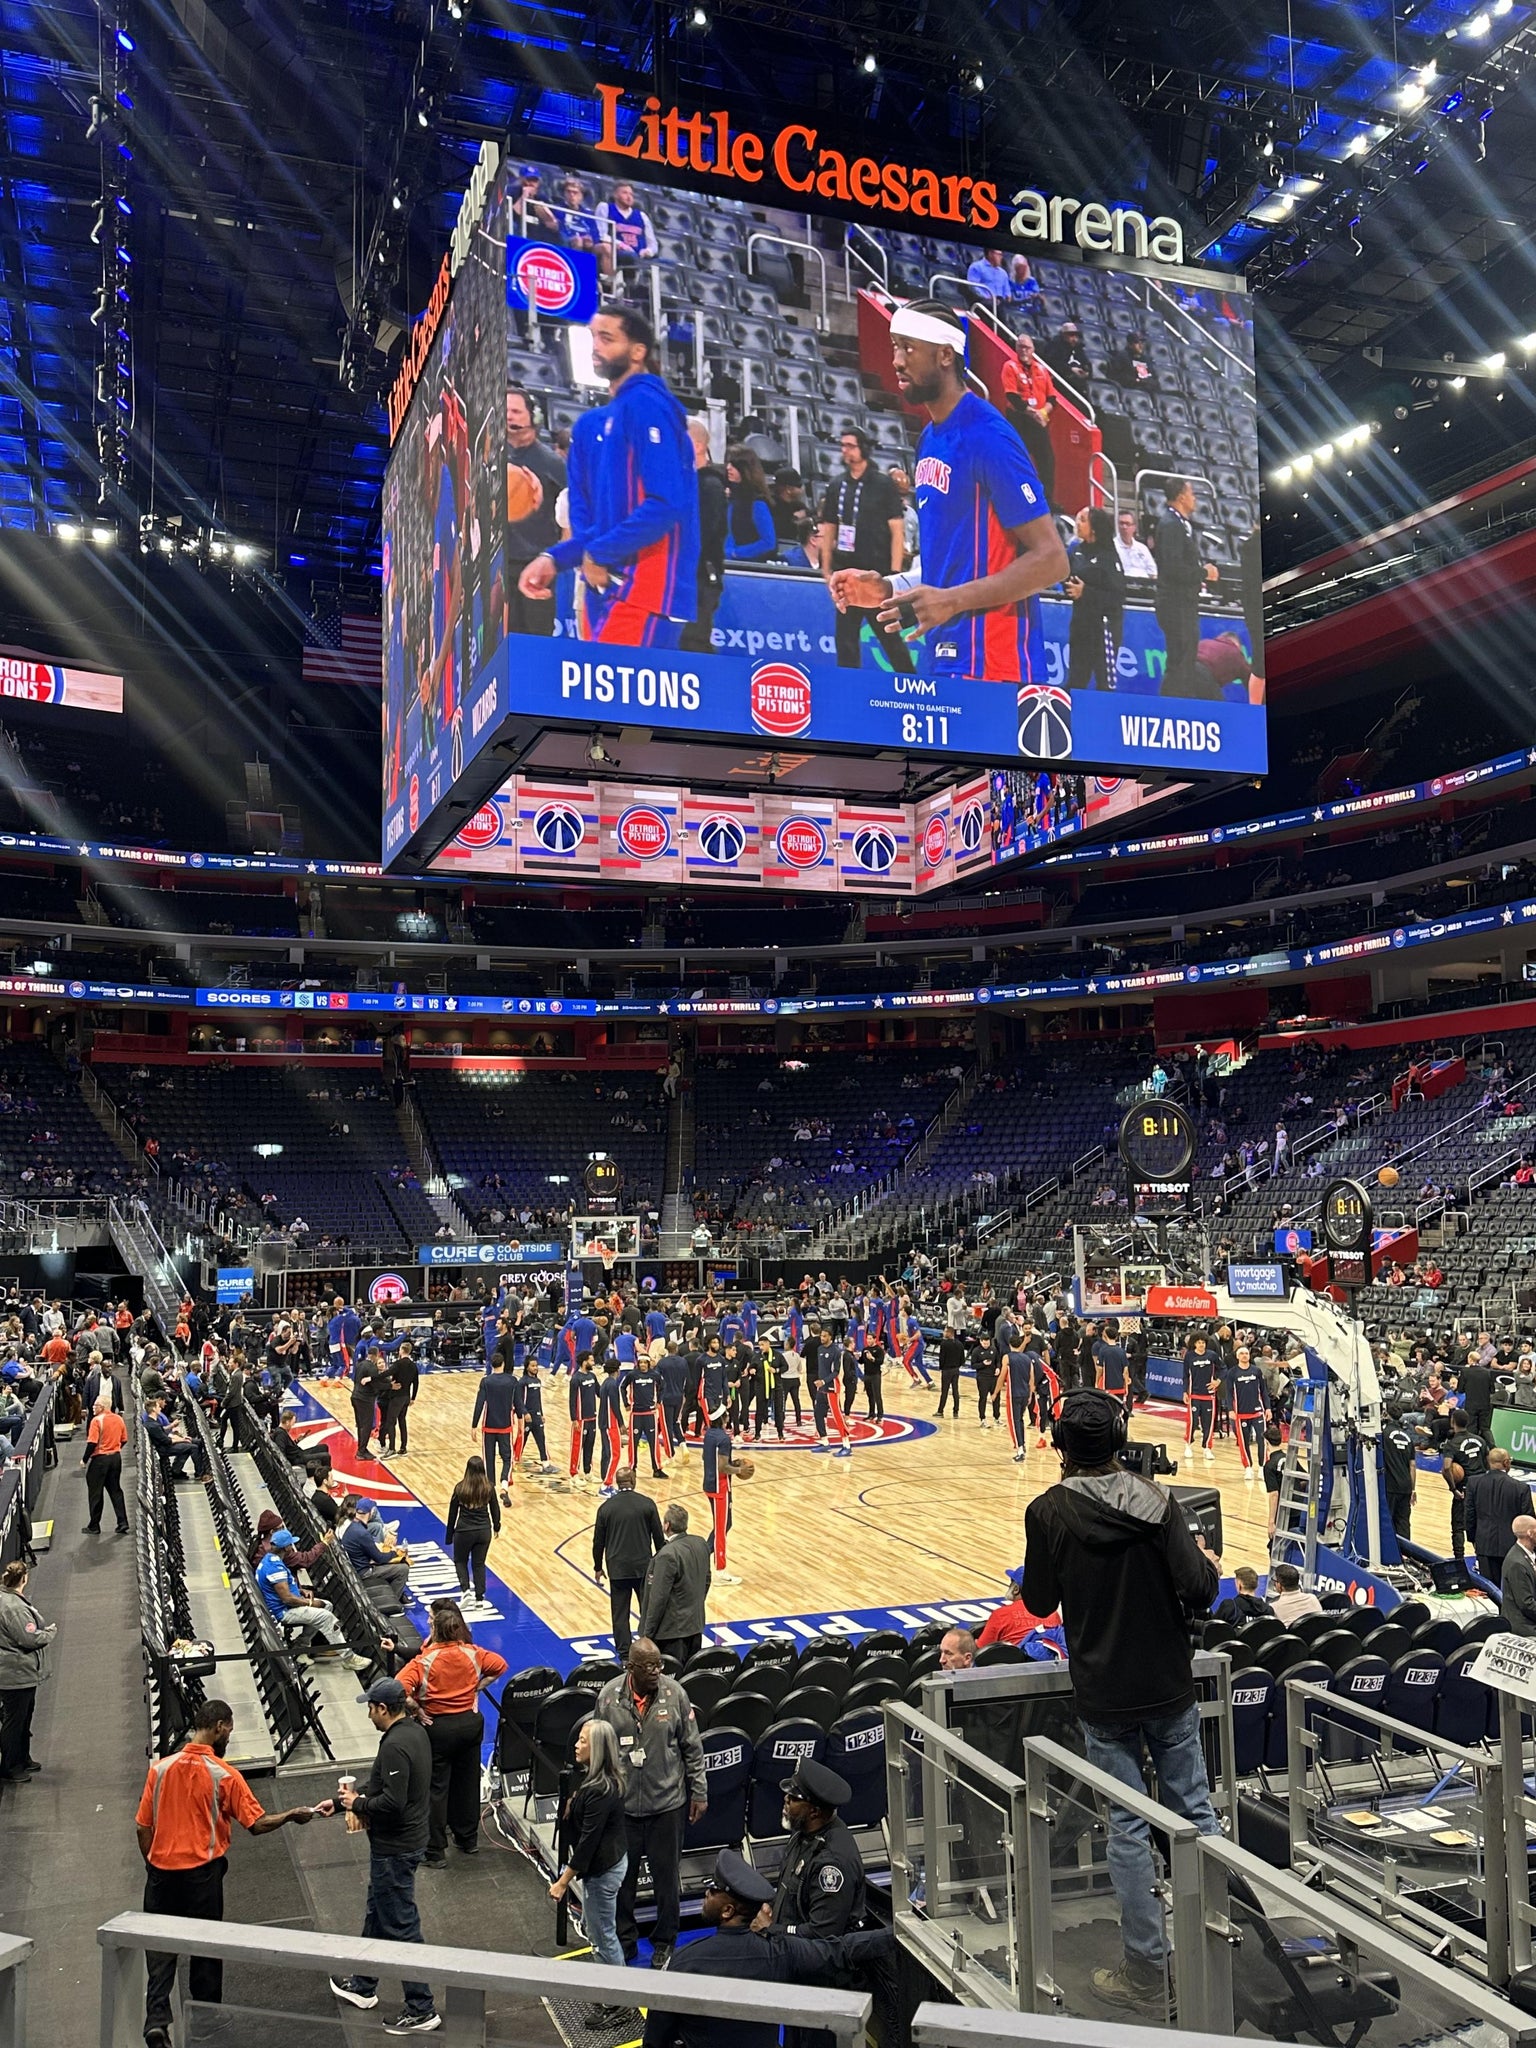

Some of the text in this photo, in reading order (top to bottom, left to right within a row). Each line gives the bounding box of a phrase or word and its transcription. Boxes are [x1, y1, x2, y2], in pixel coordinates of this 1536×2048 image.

[594, 83, 1184, 265] Little Caesars arena
[450, 140, 499, 279] arena
[710, 627, 811, 655] expert
[562, 660, 700, 710] PISTONS
[894, 677, 936, 697] UWM
[757, 684, 804, 700] DETROIT
[757, 698, 805, 714] PISTONS
[869, 698, 915, 711] COUNTDOWN
[925, 705, 962, 715] GAMETIME
[902, 713, 949, 745] 8:11
[1121, 714, 1221, 753] WIZARDS
[1331, 789, 1416, 815] 100 YEARS OF THRILLS
[629, 824, 660, 834] DETROIT
[629, 833, 661, 842] PISTONS
[787, 834, 817, 844] DETROIT
[1127, 834, 1209, 853] 100 YEARS OF THRILLS
[787, 843, 818, 852] PISTONS
[98, 848, 186, 864] 100 YEARS OF THRILLS
[1319, 936, 1390, 960] 100 YEARS OF THRILLS
[1106, 971, 1184, 989] 100 YEARS OF THRILLS
[14, 981, 26, 991] OF
[28, 982, 65, 994] THRILLS
[207, 993, 271, 1004] SCORES
[316, 996, 328, 1006] VS
[428, 998, 439, 1009] VS
[892, 993, 974, 1005] 100 YEARS OF THRILLS
[535, 1001, 546, 1011] VS
[677, 1002, 760, 1011] 100 YEARS OF THRILLS
[1143, 1117, 1178, 1136] 8:11
[1149, 1183, 1190, 1193] TISSOT
[1337, 1199, 1361, 1215] 8:11
[431, 1245, 477, 1259] CURE
[497, 1253, 524, 1262] CLUB
[1339, 1251, 1364, 1260] TISSOT
[500, 1273, 528, 1283] GREY
[1234, 1267, 1276, 1280] mortgage
[217, 1279, 245, 1287] CURE
[1246, 1281, 1278, 1292] matchup
[1410, 1671, 1431, 1682] 123
[1357, 1678, 1377, 1689] 123
[513, 1685, 554, 1698] FIEGERLAW
[1236, 1691, 1258, 1703] 123
[850, 1732, 876, 1748] 123
[778, 1744, 805, 1757] 123
[704, 1752, 732, 1769] 123
